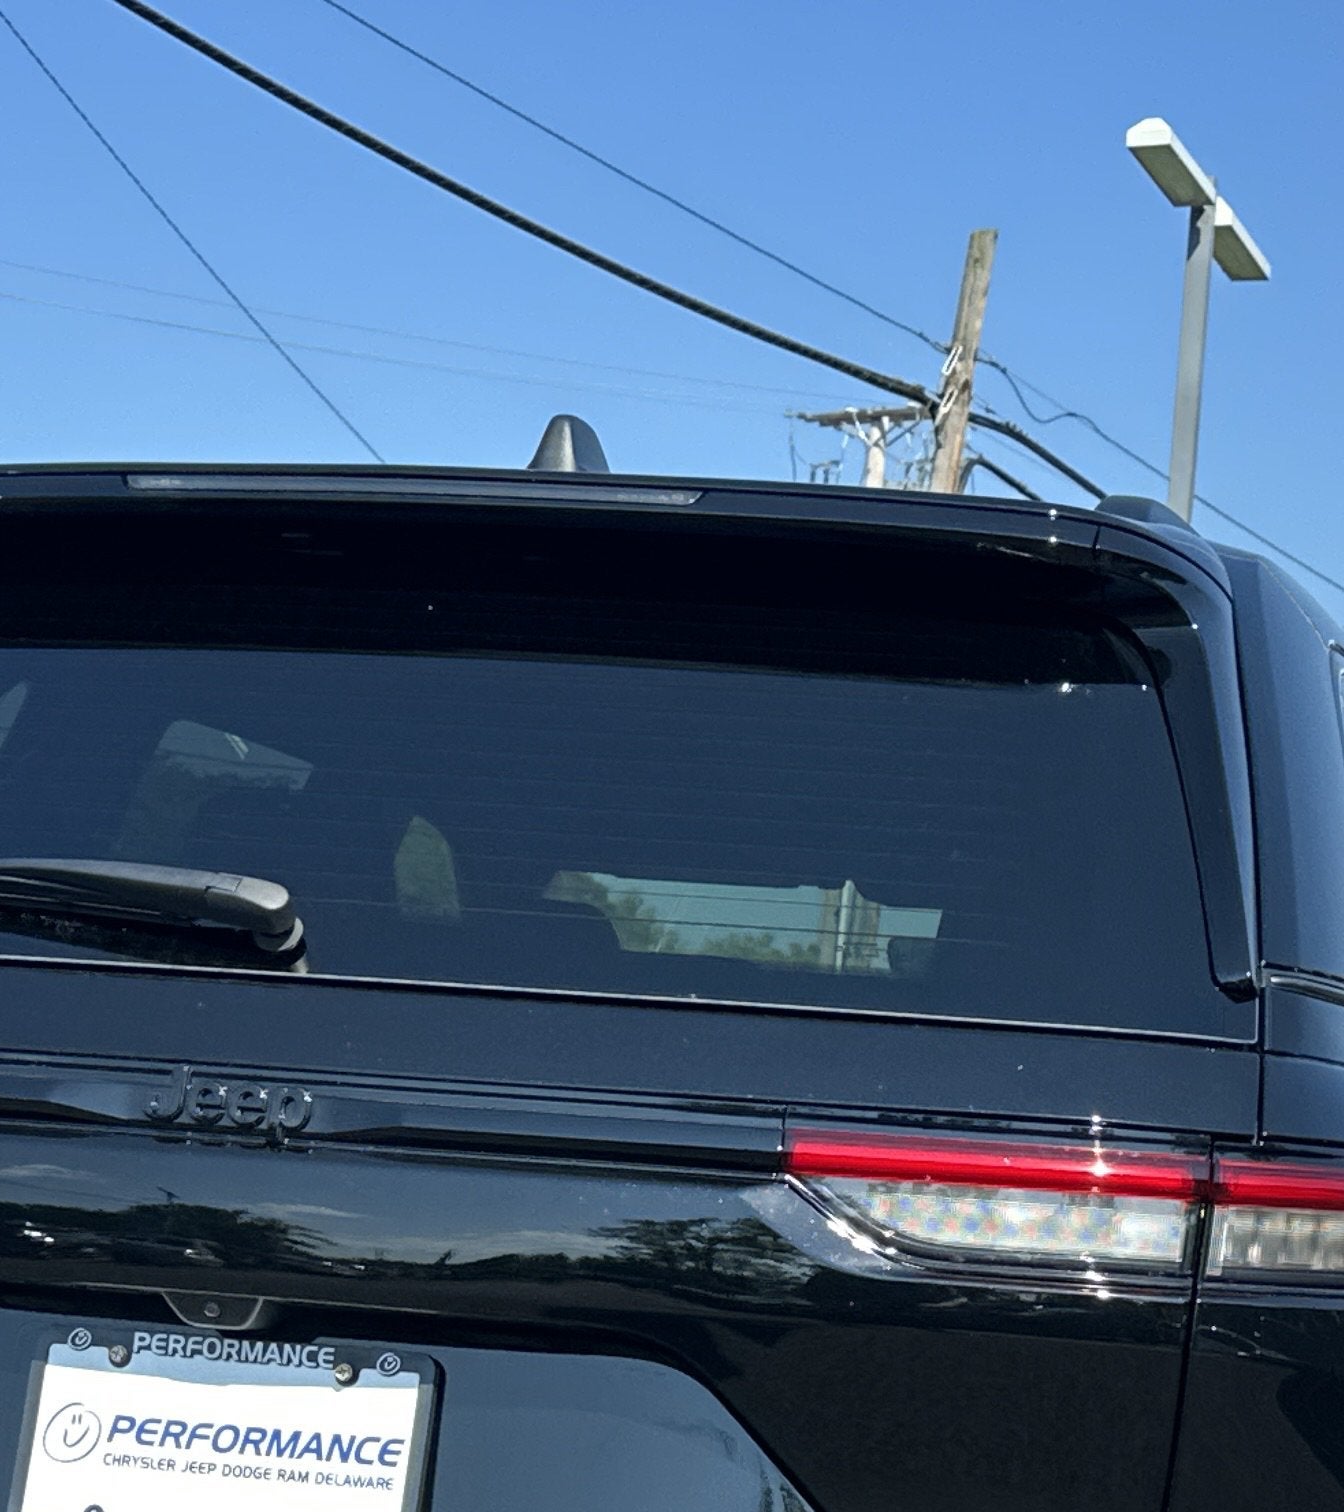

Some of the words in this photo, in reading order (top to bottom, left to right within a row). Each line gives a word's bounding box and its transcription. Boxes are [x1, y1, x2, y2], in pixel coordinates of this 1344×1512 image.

[143, 1064, 314, 1149] Jeep
[132, 1330, 337, 1370] PERFORMANCE
[106, 1414, 406, 1468] PERFORMANCE
[102, 1452, 177, 1472] CHRYSLER
[181, 1460, 217, 1475] JEEP
[221, 1463, 272, 1481] DODGE
[276, 1469, 310, 1484] RAM
[314, 1472, 395, 1491] DELAWARE
